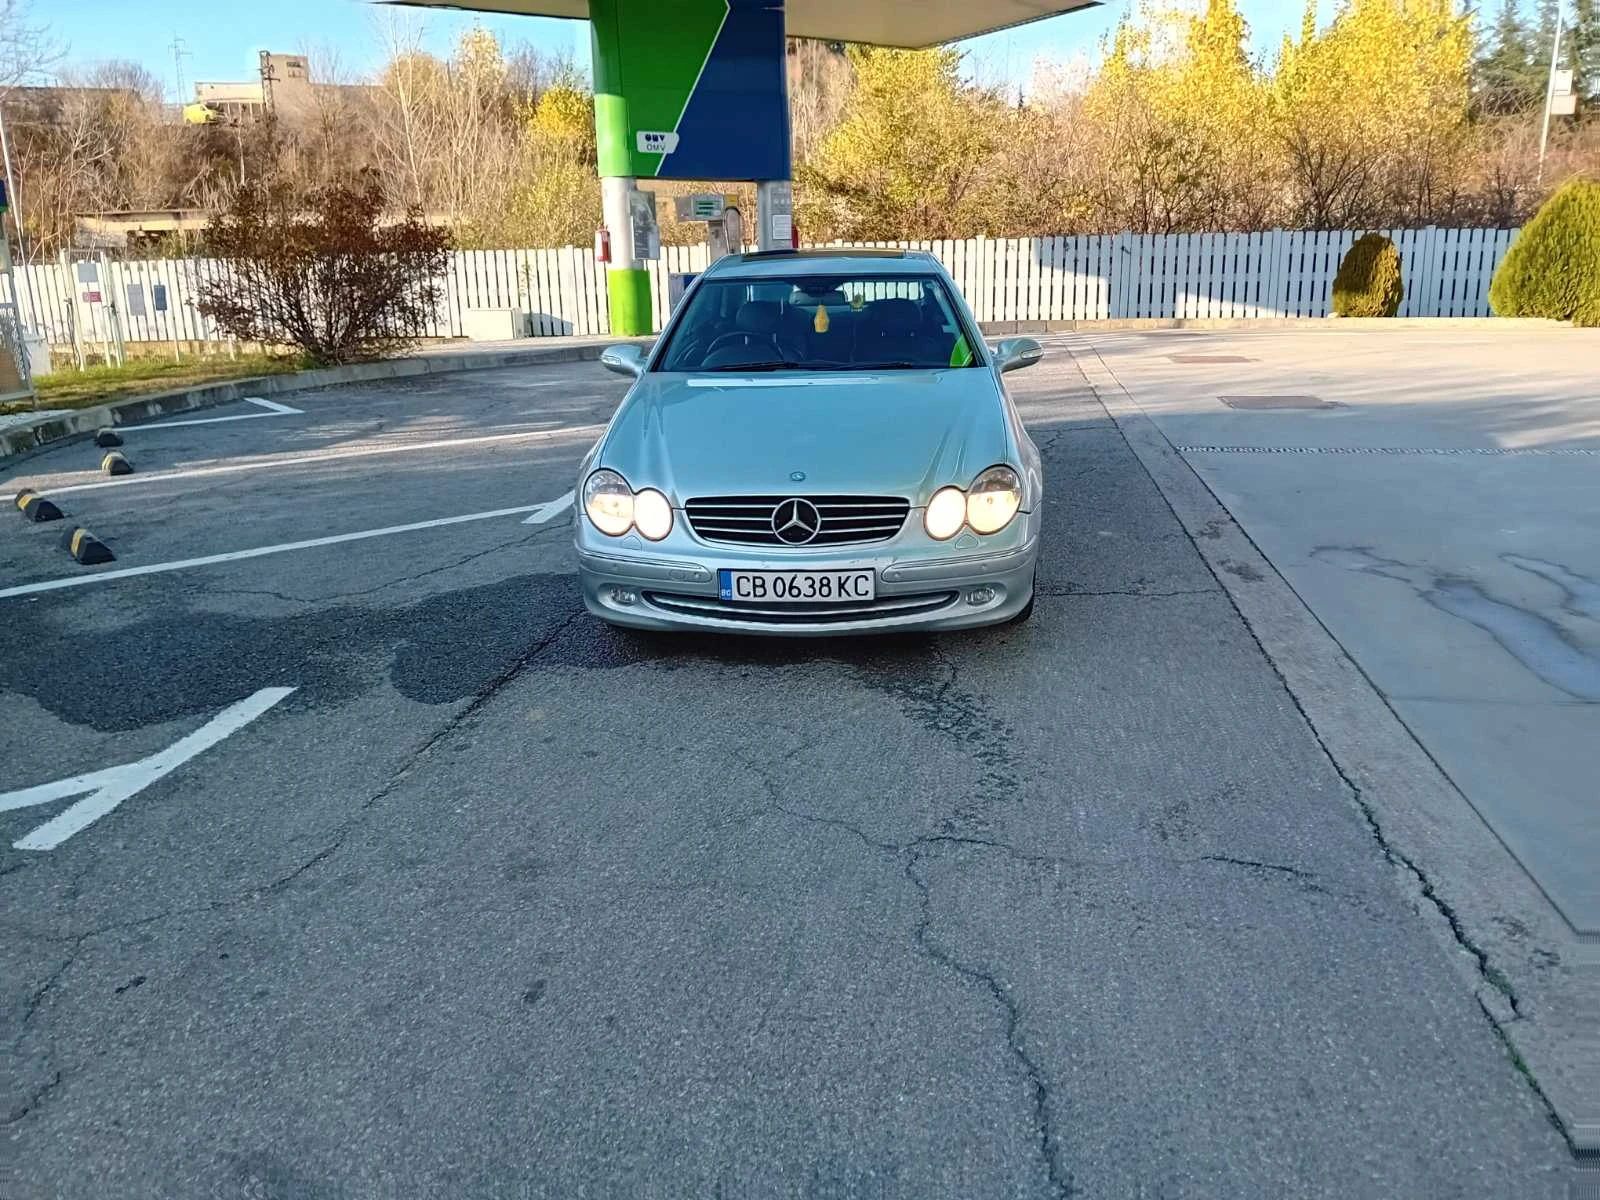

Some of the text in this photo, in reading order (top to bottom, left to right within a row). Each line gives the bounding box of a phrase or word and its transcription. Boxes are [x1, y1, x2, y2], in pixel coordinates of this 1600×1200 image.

[645, 134, 665, 142] OMV
[646, 143, 665, 151] OMV
[736, 574, 869, 598] CB 0638 KC
[721, 589, 731, 597] BG
